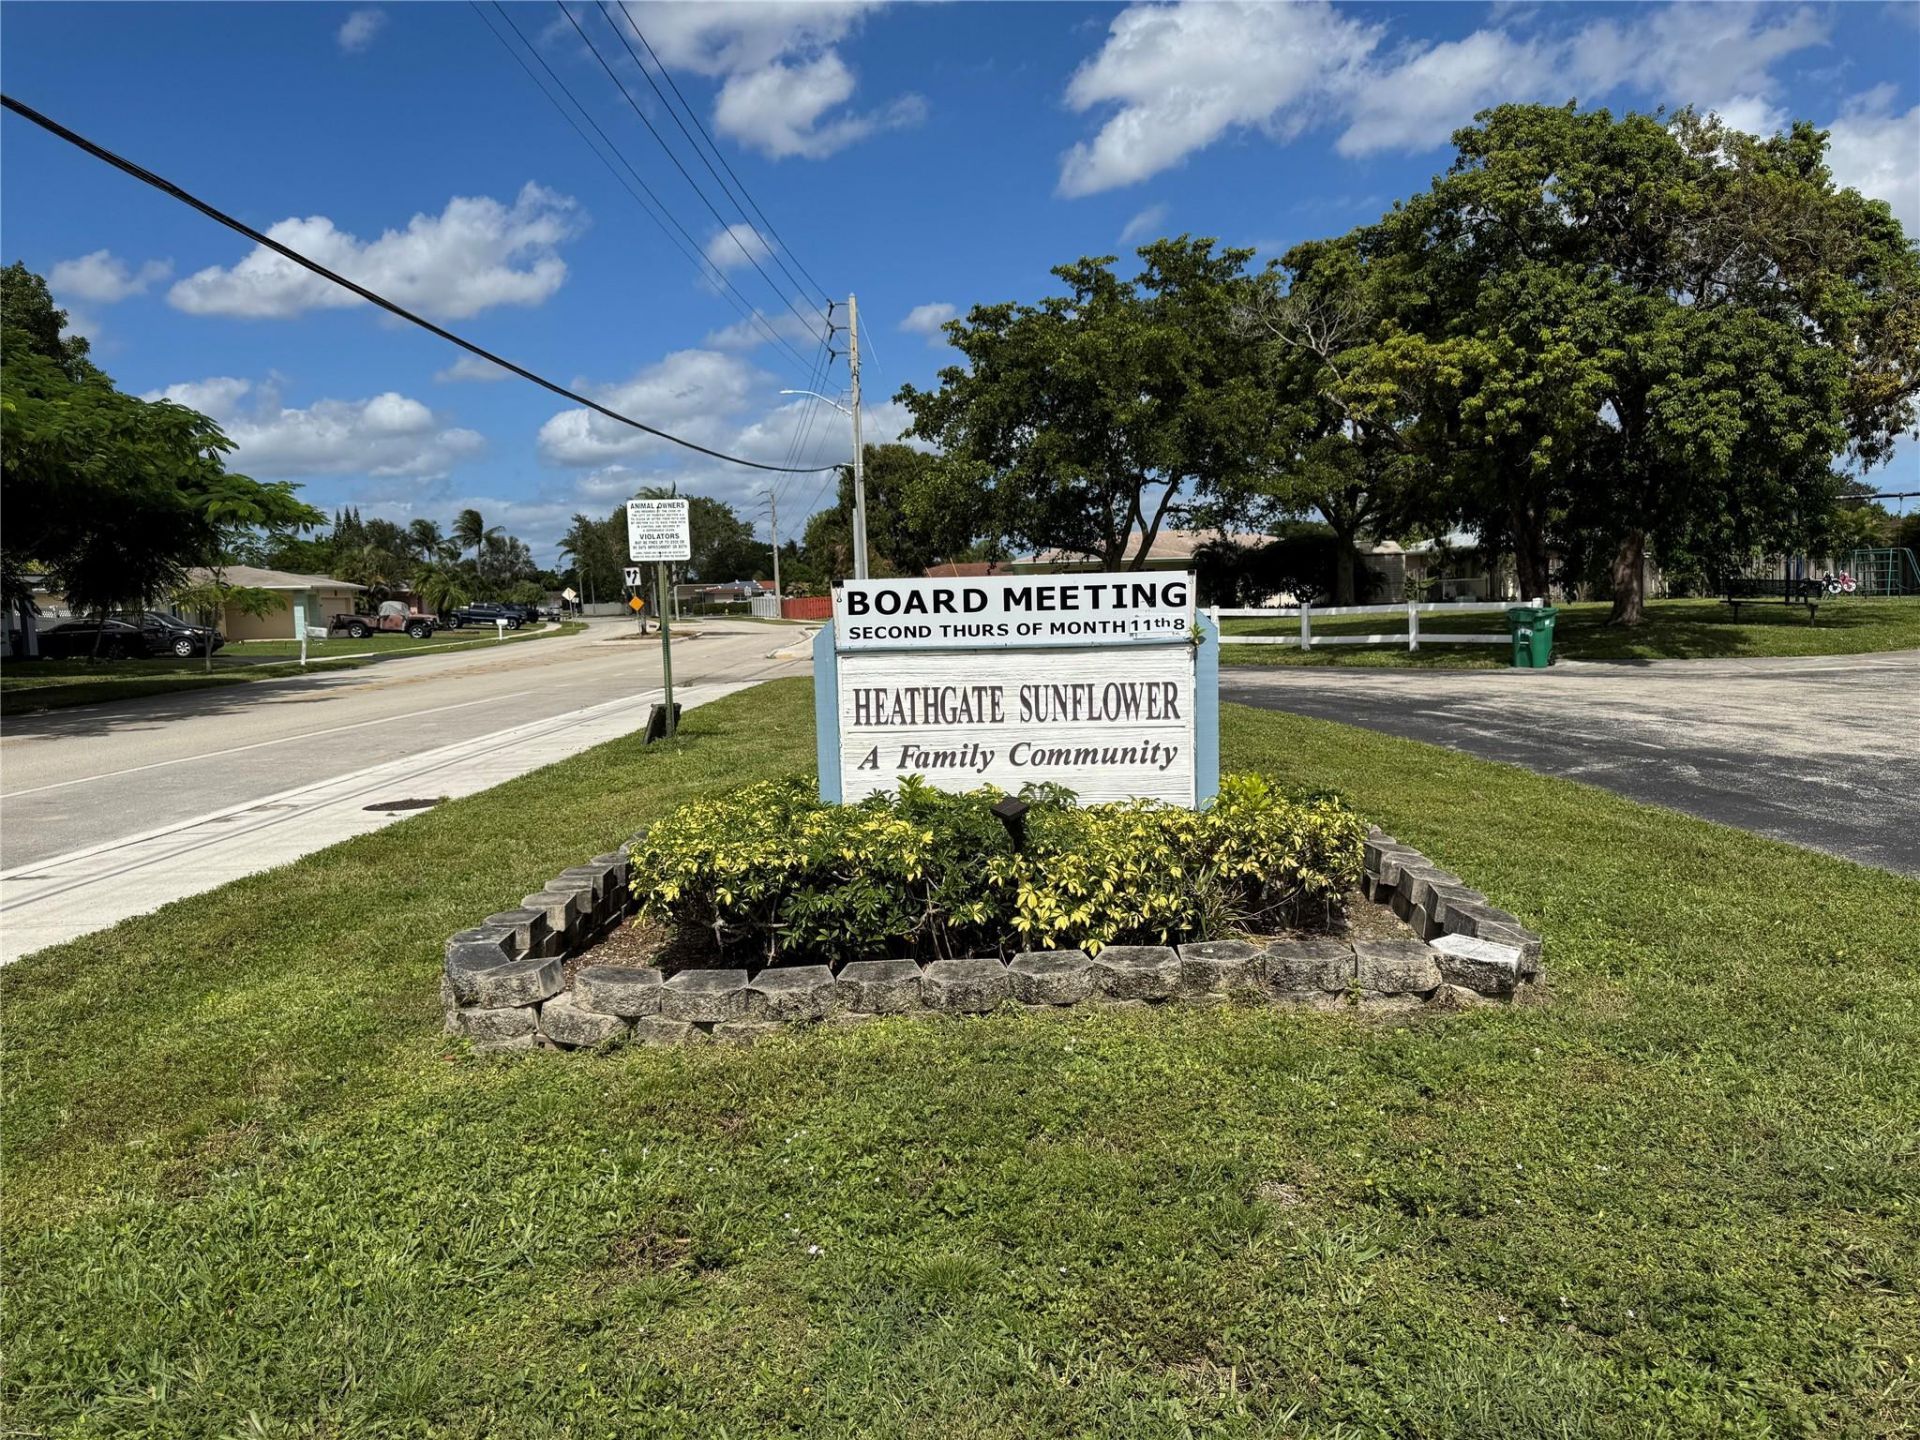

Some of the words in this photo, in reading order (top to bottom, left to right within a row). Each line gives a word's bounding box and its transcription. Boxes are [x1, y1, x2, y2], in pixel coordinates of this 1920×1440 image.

[847, 588, 988, 616] BOARD
[1003, 582, 1187, 612] MEETING
[849, 625, 932, 639] SECOND
[939, 623, 1009, 638] THURS
[1016, 622, 1043, 636] OF
[1050, 621, 1126, 635] MONTH
[853, 685, 1005, 726] HEATHGATE
[1020, 681, 1181, 723] SUNFLOWER
[857, 745, 880, 770] A
[896, 743, 996, 773] Family
[1008, 739, 1179, 771] Community
